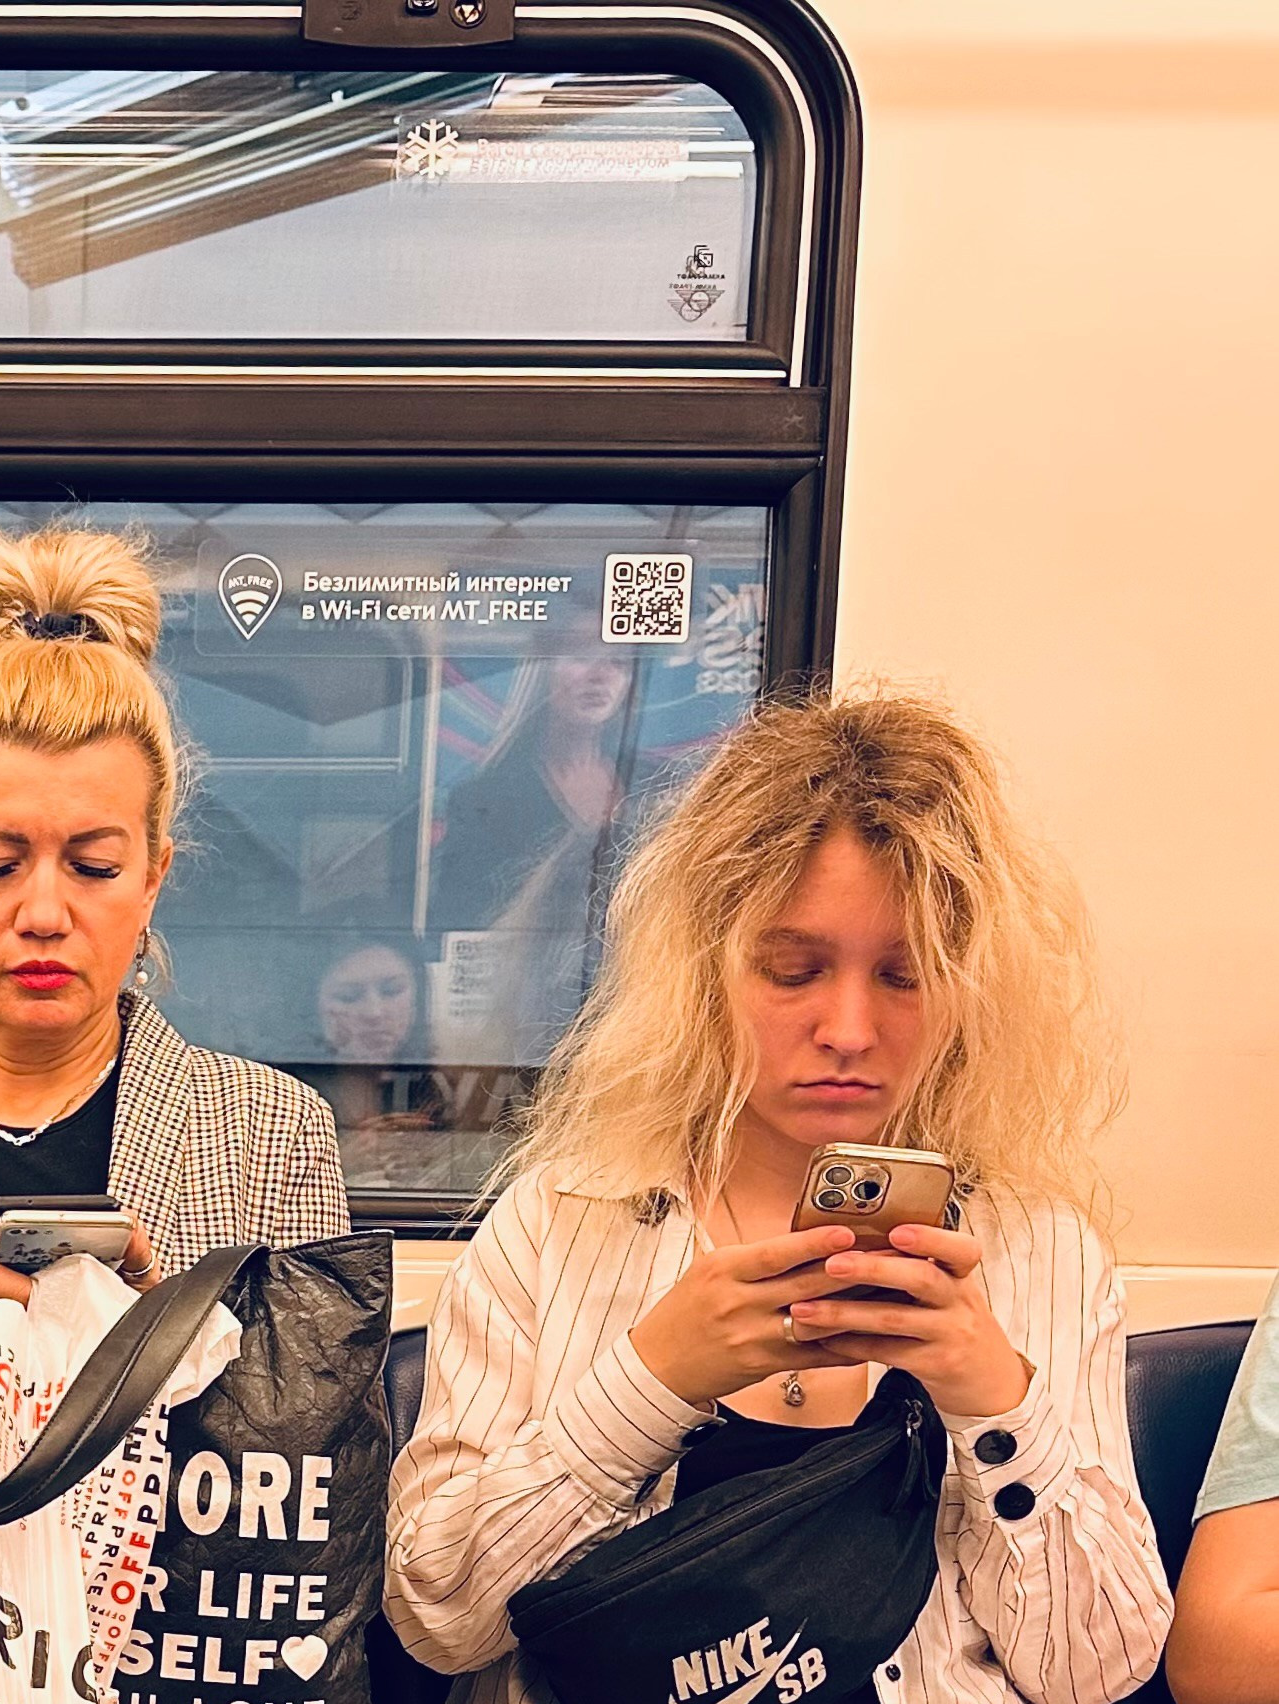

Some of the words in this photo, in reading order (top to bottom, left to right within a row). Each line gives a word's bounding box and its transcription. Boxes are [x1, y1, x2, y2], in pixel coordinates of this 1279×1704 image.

[228, 575, 274, 590] MT_FREE
[303, 572, 460, 592] Безлимитный
[466, 576, 572, 596] интернет
[302, 604, 315, 620] в
[319, 600, 381, 620] Wi-Fi
[386, 604, 436, 620] сети
[440, 600, 548, 625] MT_FREE
[157, 1451, 333, 1541] ORE
[137, 1565, 169, 1612] R
[198, 1569, 327, 1620] LIFE
[117, 1629, 278, 1685] SELF
[672, 1616, 778, 1700] NIKE
[775, 1647, 827, 1704] SB
